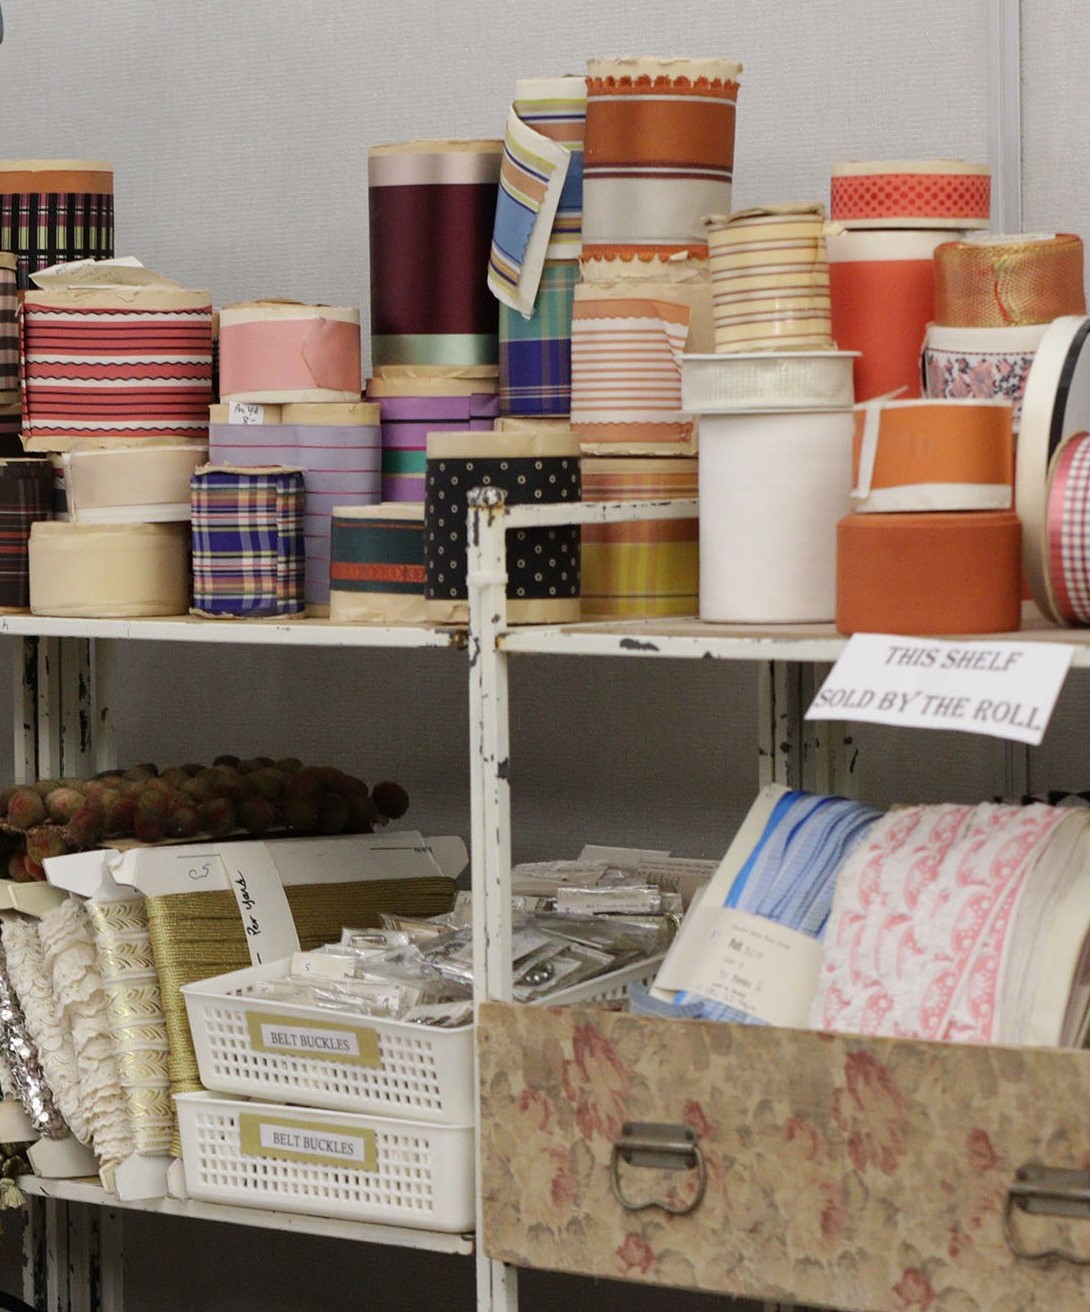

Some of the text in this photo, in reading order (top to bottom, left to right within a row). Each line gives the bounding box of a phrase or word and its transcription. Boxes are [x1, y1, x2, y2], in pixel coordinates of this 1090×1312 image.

[885, 646, 1023, 671] THIS SHELF
[813, 688, 1041, 731] SOLD BY THE ROLL
[270, 1031, 351, 1052] BELT BUCKLES
[272, 1131, 354, 1155] BELT BUCKLES
